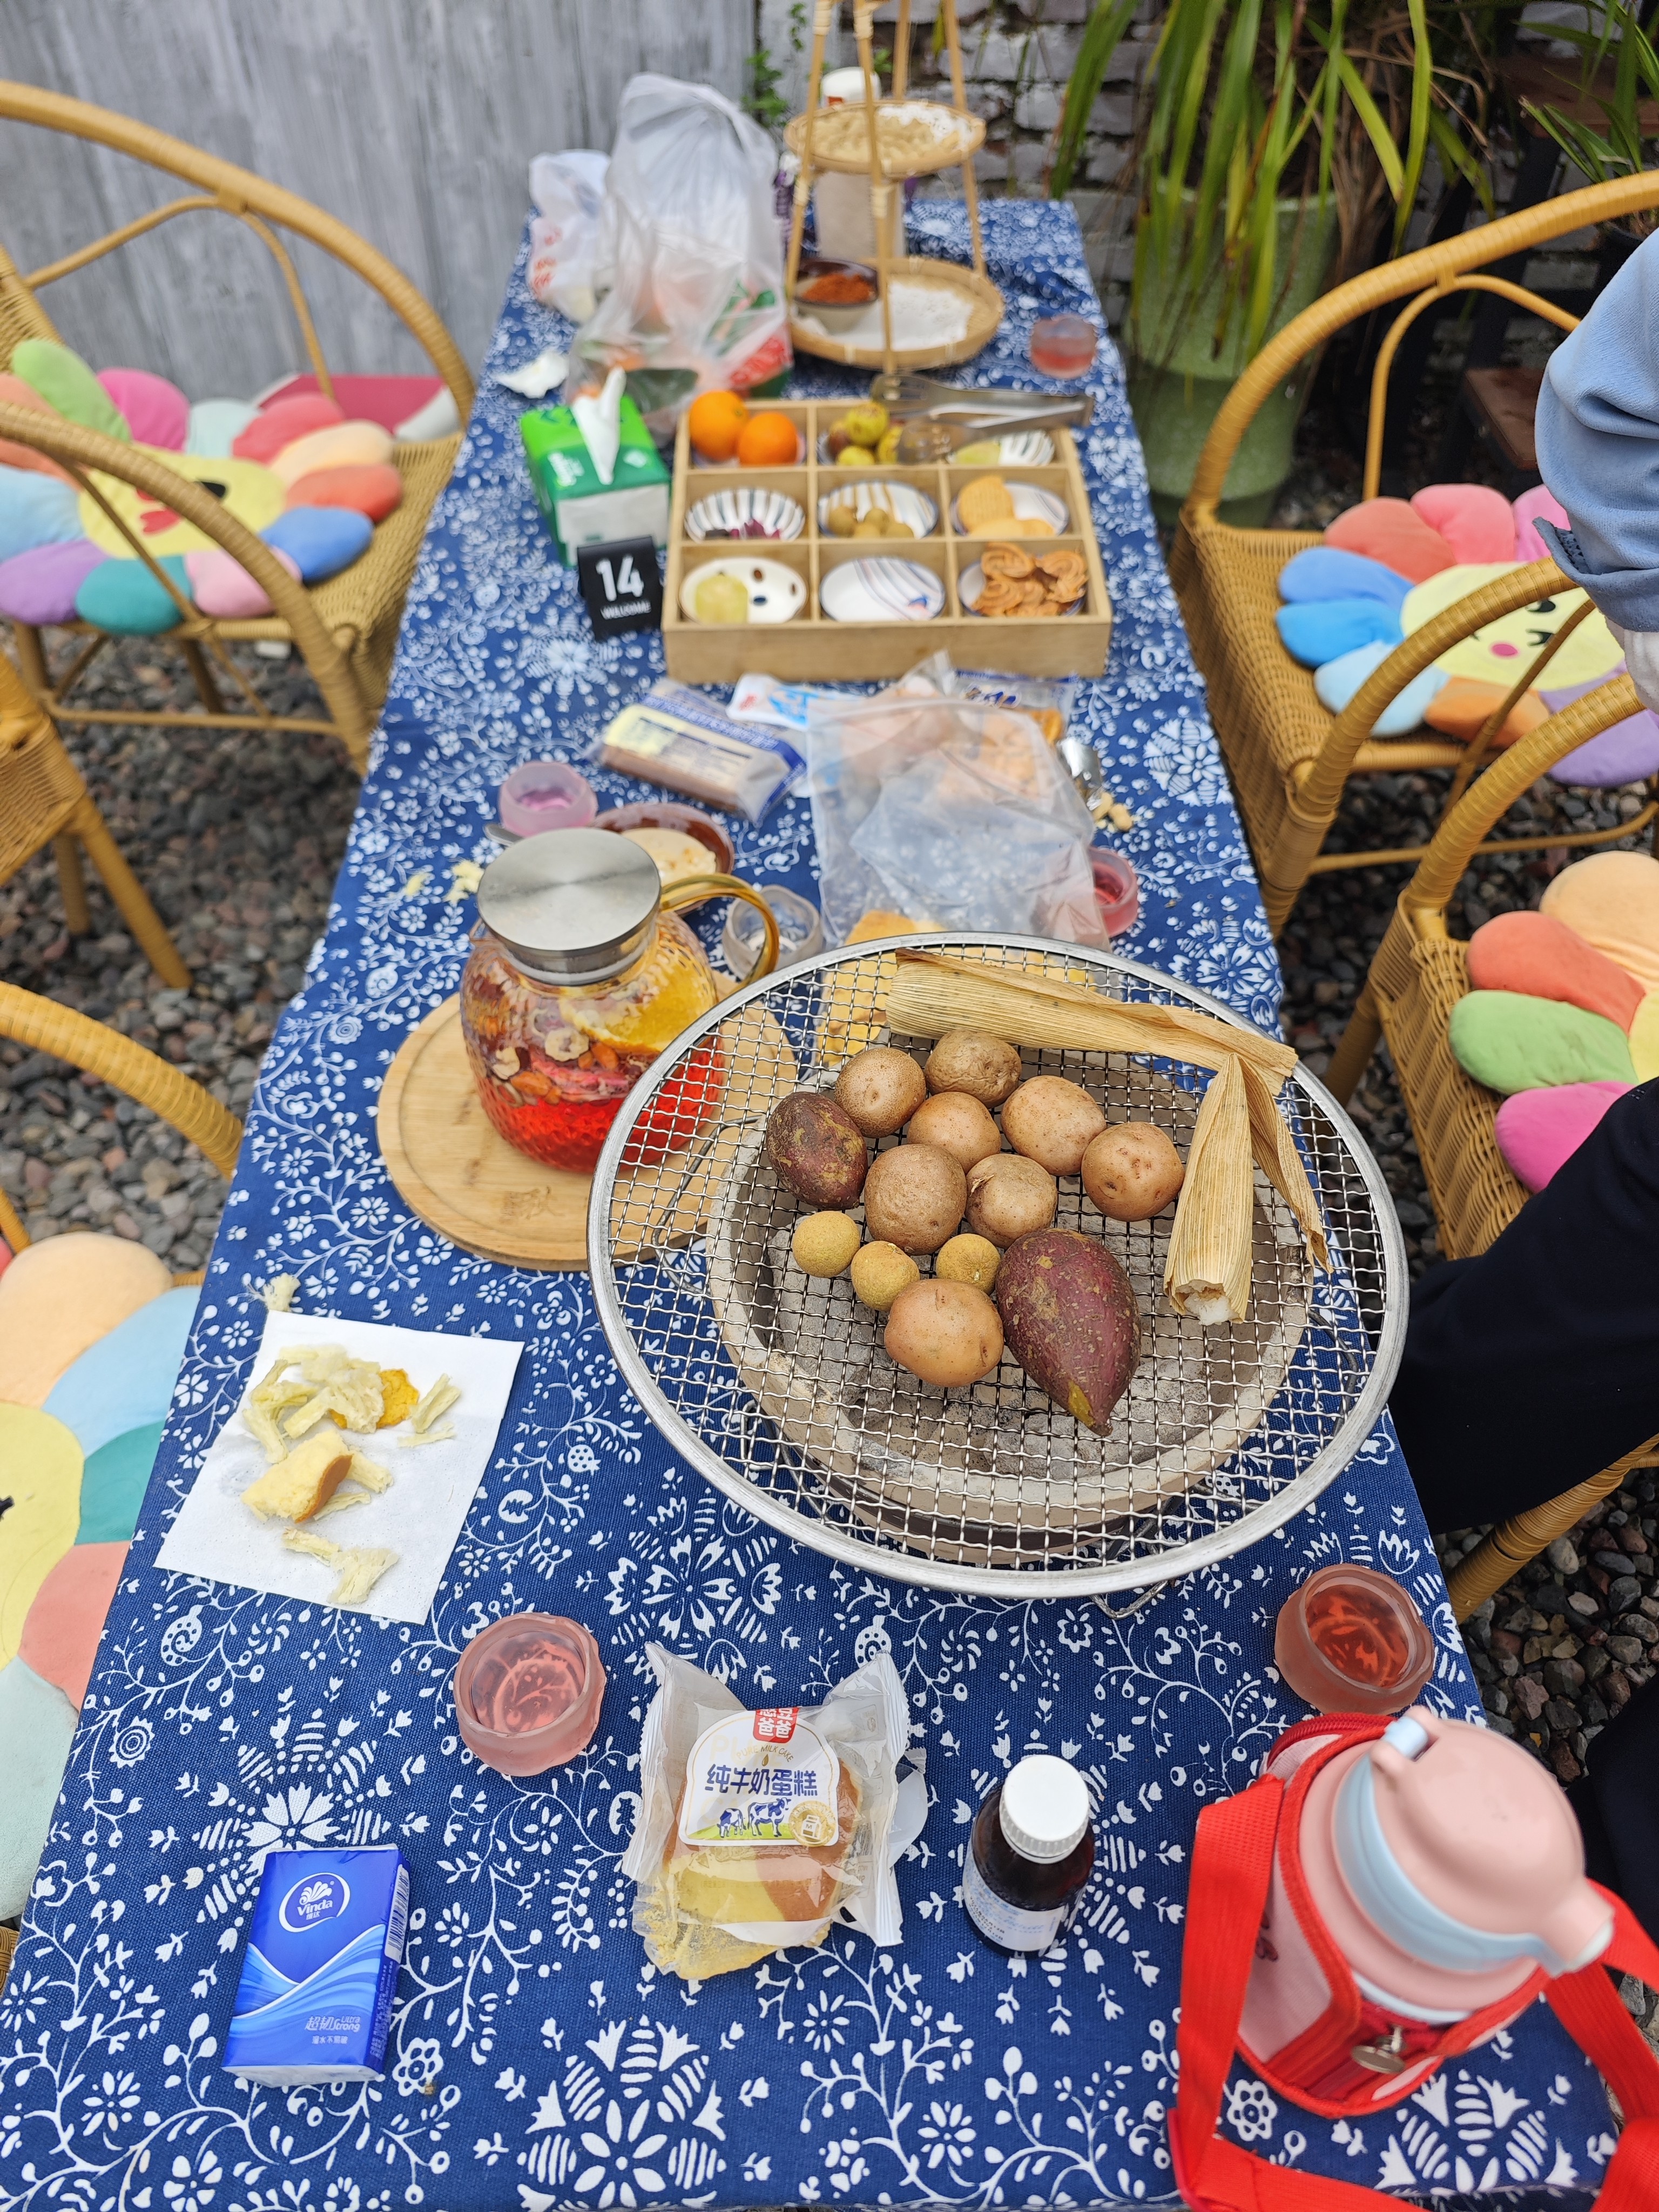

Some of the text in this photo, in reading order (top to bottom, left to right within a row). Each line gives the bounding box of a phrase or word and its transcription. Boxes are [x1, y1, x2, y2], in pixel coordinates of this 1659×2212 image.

[596, 554, 644, 602] 14
[757, 1717, 792, 1738] 爸爸
[737, 1745, 794, 1763] PURE MILK CAKE
[705, 1764, 818, 1797] 纯牛奶蛋糕
[296, 1899, 333, 1916] Vinda
[304, 2016, 334, 2031] 超韧
